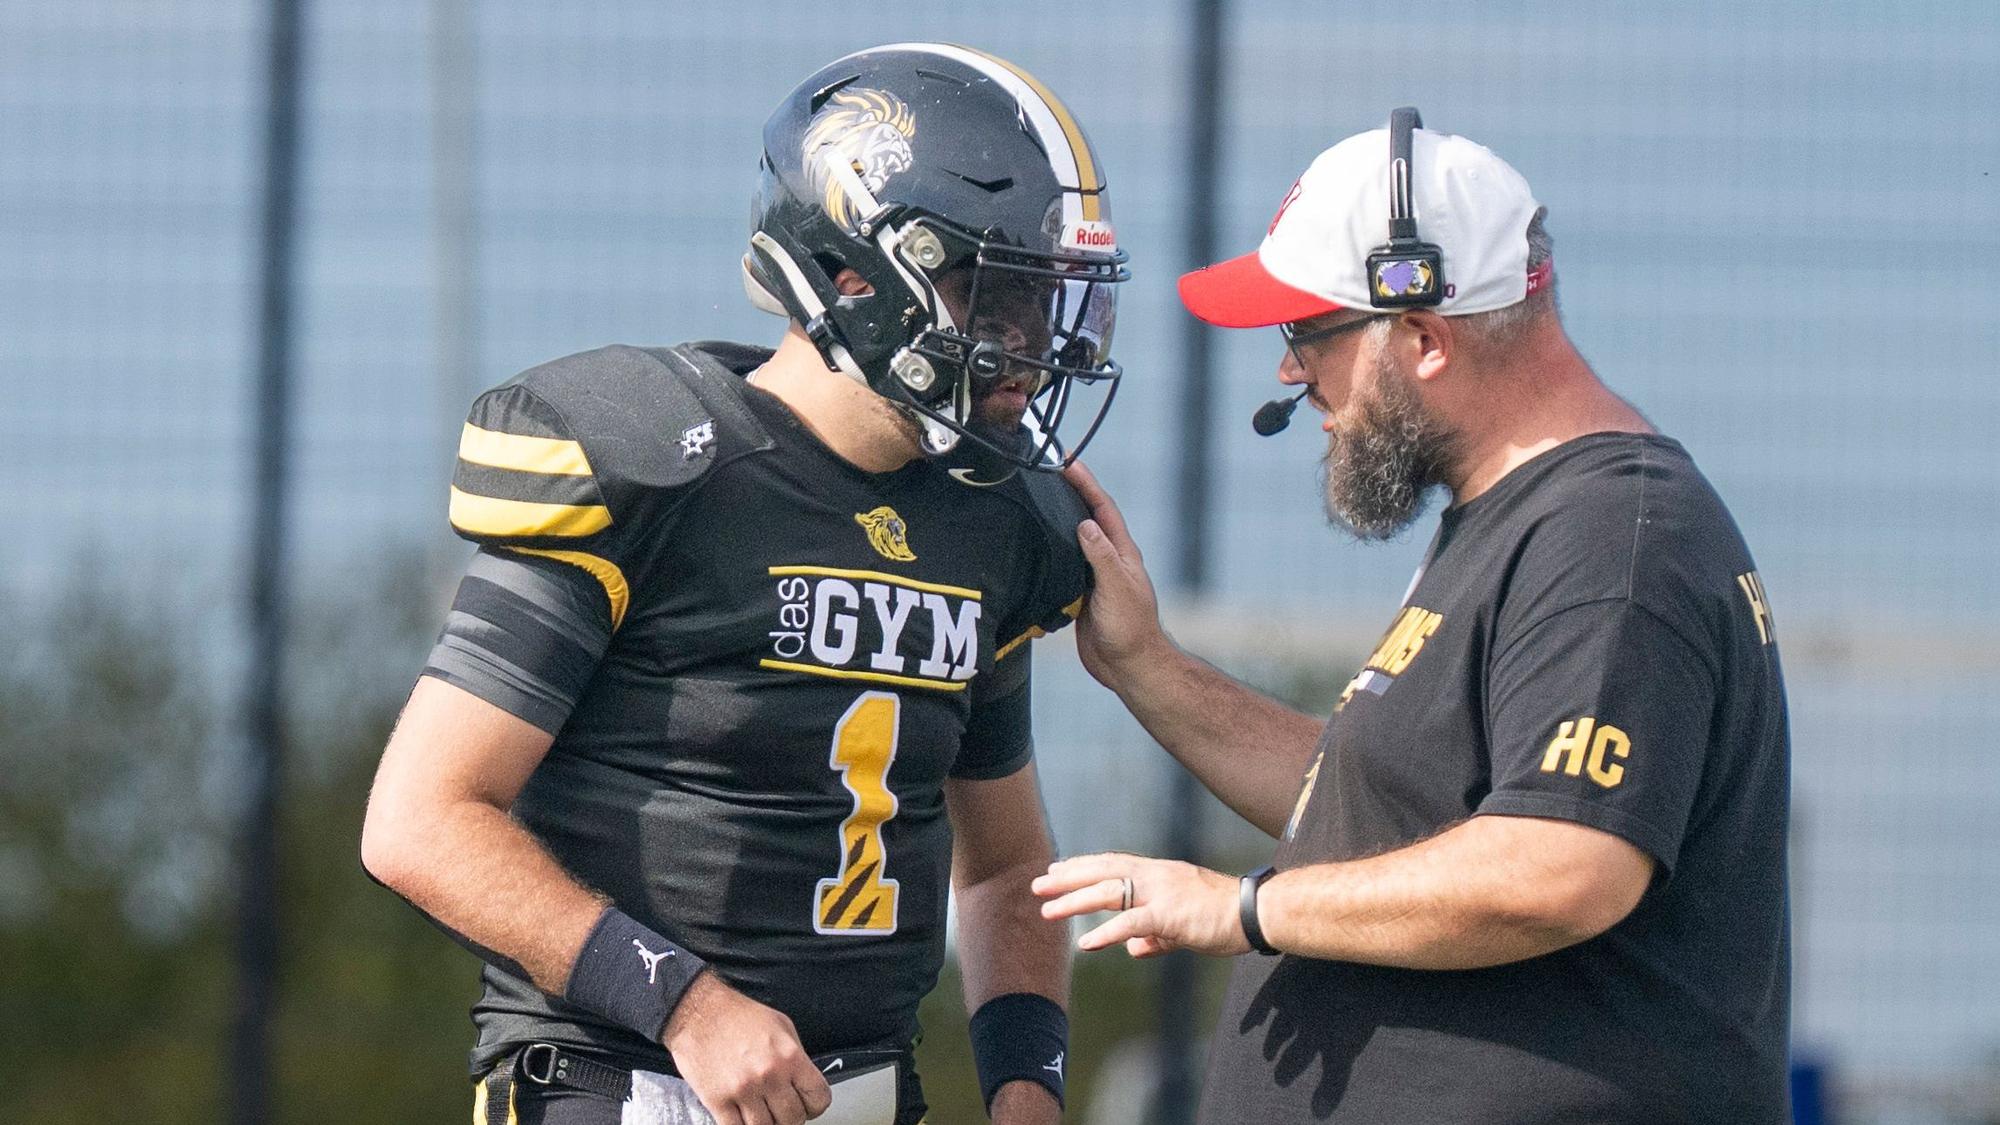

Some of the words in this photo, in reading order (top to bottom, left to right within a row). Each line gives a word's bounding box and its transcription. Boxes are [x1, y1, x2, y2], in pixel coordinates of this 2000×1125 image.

[1076, 227, 1117, 246] Ridde
[769, 576, 810, 659] das
[810, 577, 982, 681] GYM
[1540, 717, 1632, 789] HC
[812, 690, 901, 936] 1
